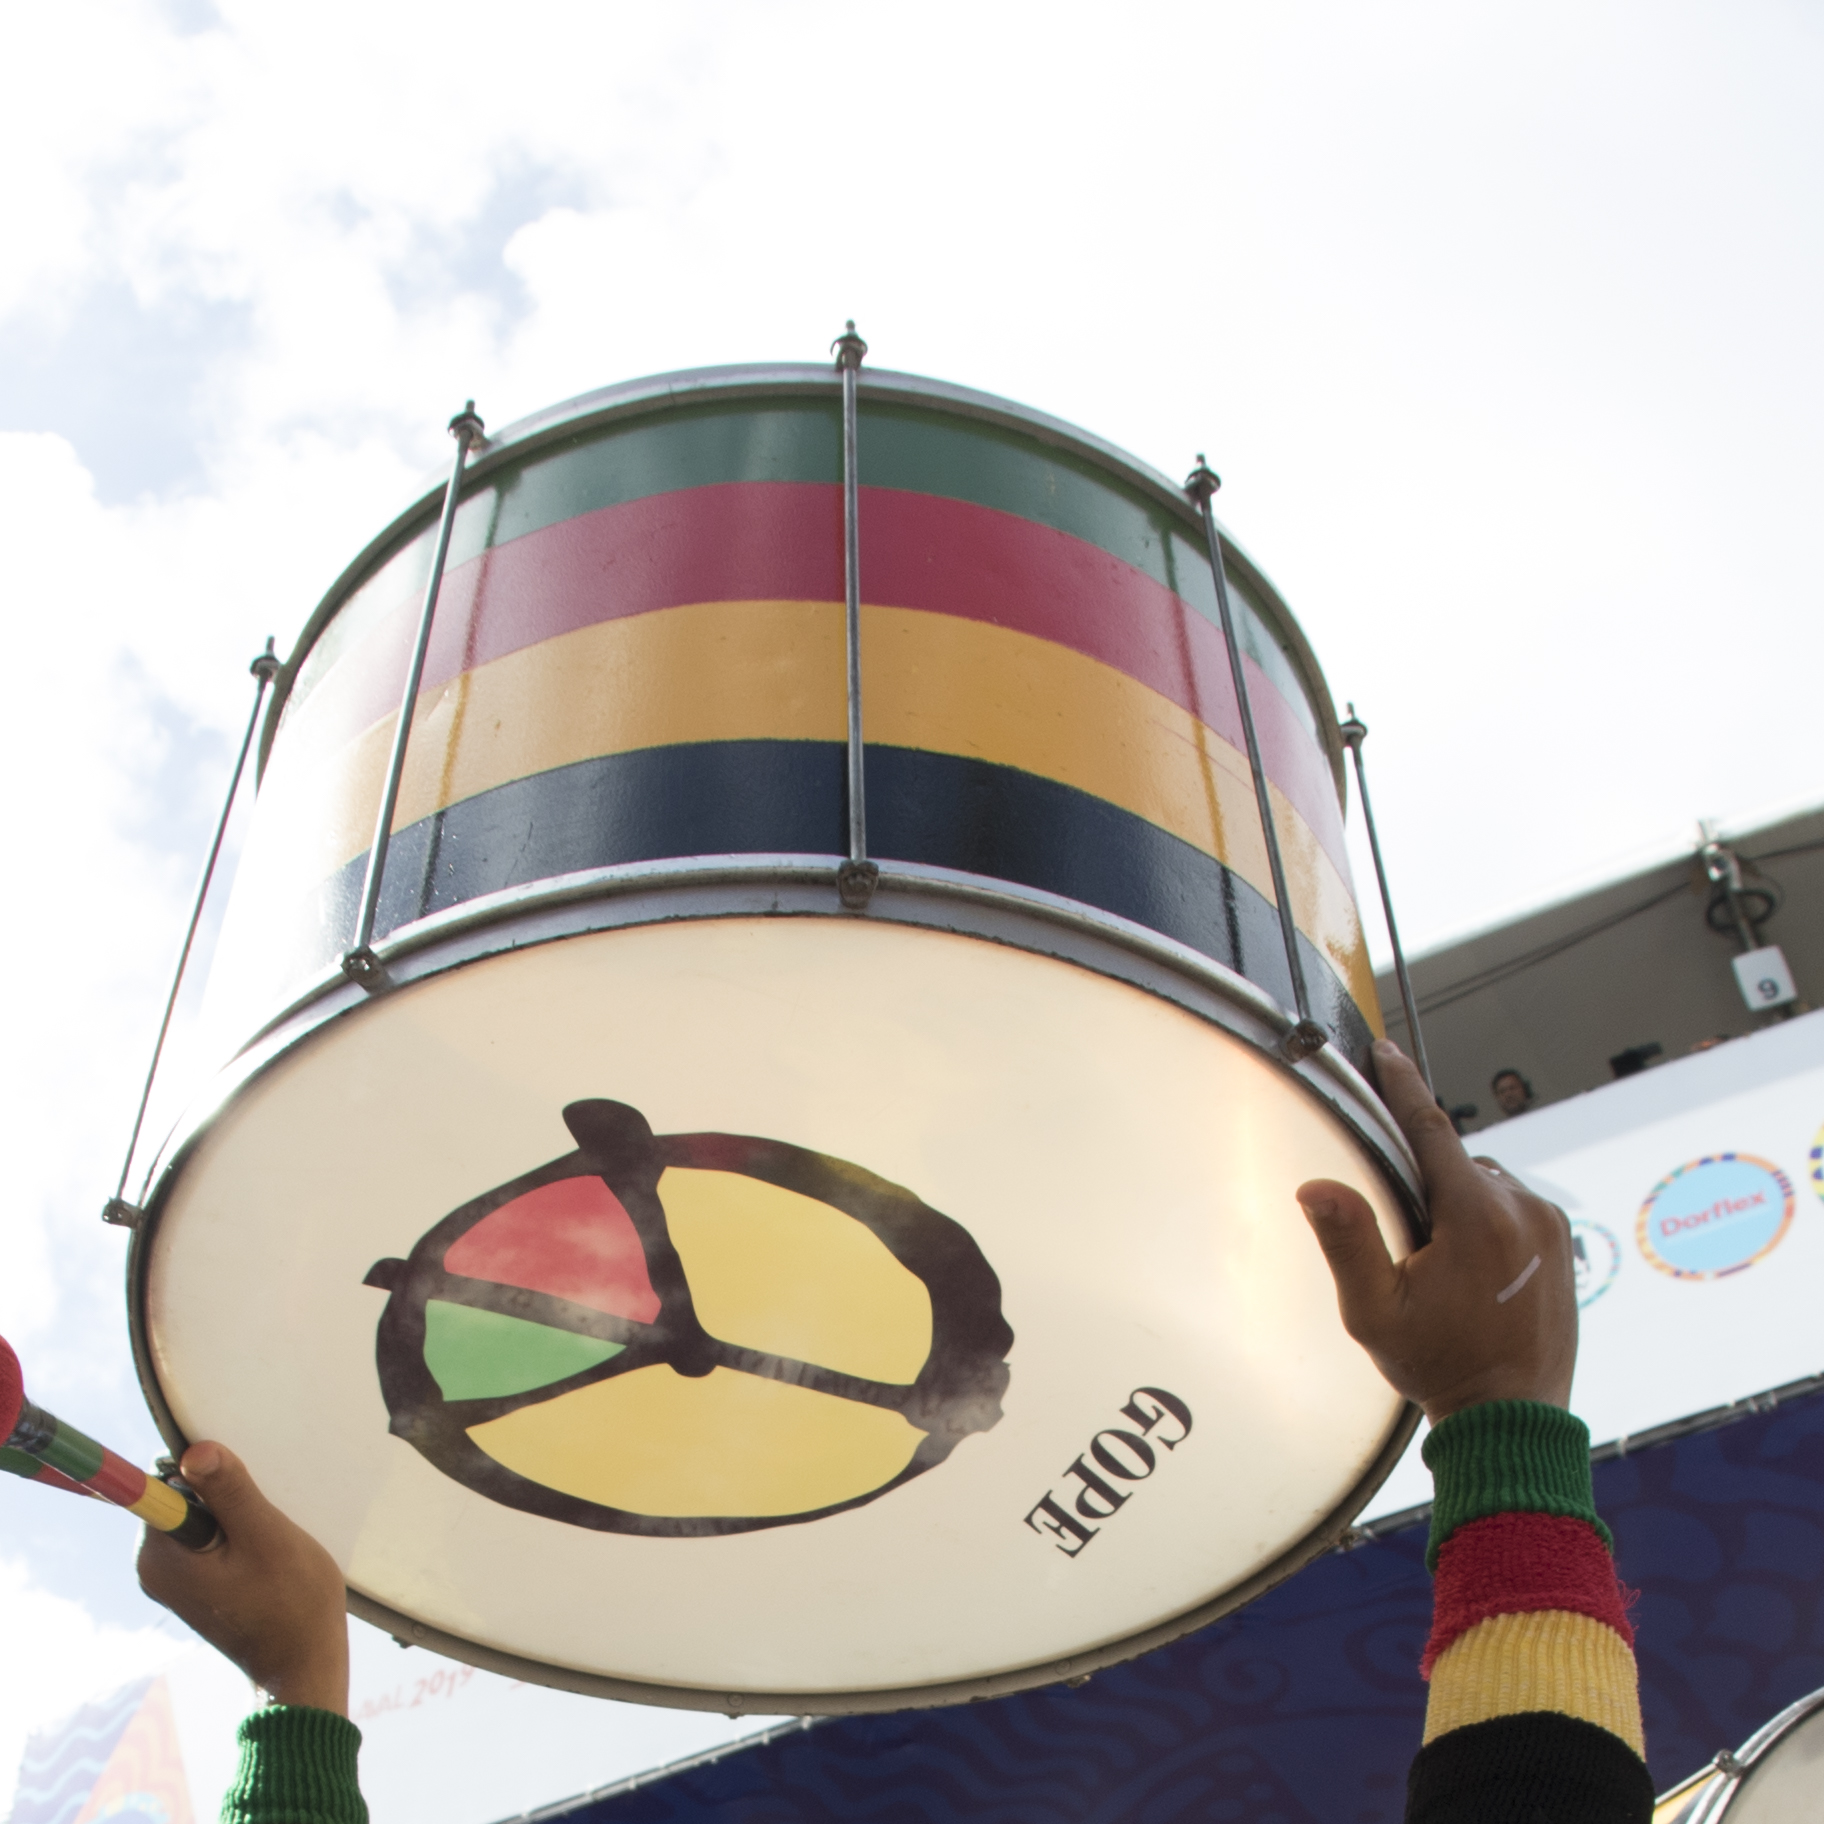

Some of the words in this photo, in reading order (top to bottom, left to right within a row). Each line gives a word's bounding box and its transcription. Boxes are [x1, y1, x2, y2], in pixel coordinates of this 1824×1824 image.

[1758, 977, 1780, 1002] 9
[1658, 1186, 1768, 1240] Dorflex
[1023, 1386, 1194, 1558] GOPE
